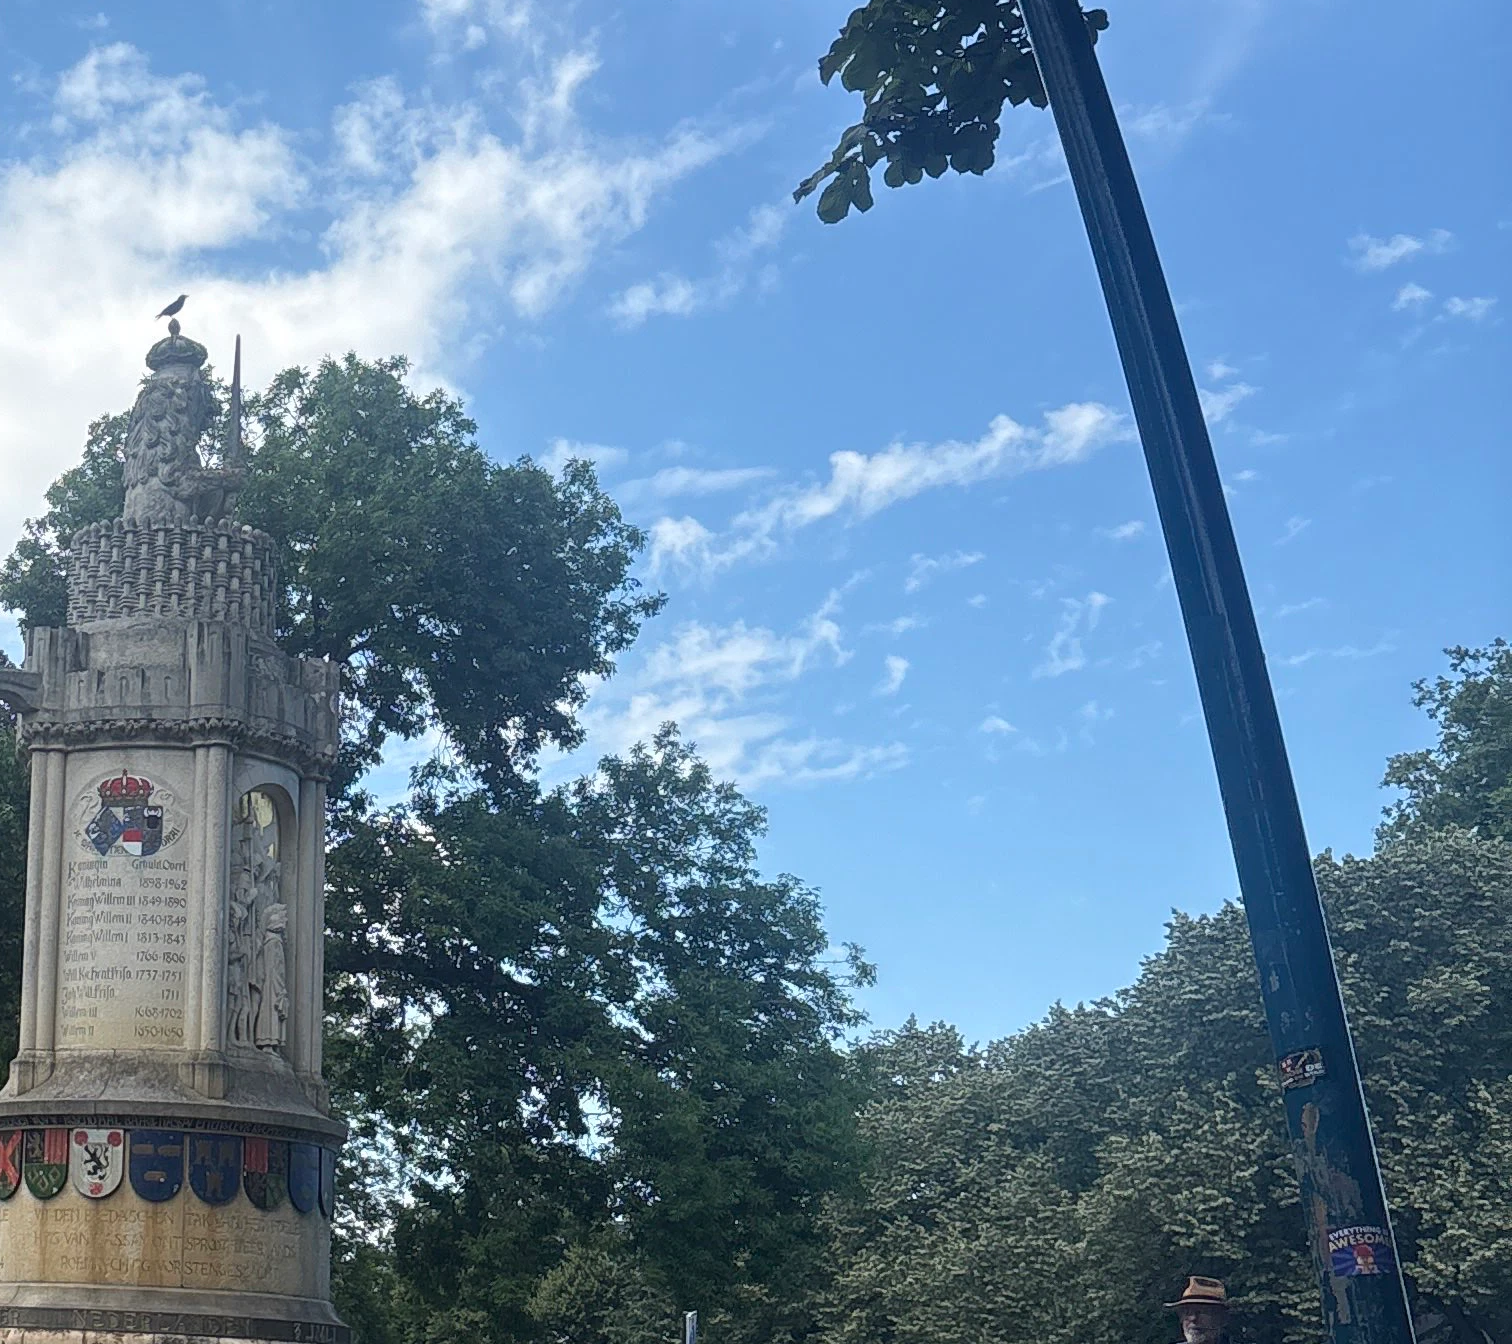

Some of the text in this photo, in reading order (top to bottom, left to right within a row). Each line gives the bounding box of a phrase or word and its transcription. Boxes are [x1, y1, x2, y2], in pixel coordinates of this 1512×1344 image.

[139, 877, 188, 890] 1898-1962
[94, 892, 125, 906] Willem
[127, 895, 136, 906] III
[138, 896, 187, 908] 1849-1890
[93, 911, 124, 924] Willem
[138, 914, 187, 927] 1840-1849
[92, 929, 123, 943] Willem
[64, 950, 88, 963] Willem
[135, 969, 182, 983] 1737-1751
[161, 989, 179, 1000] 1711
[62, 1006, 87, 1018] Willem
[54, 1208, 80, 1222] DEN
[1328, 1226, 1382, 1241] EVERYTHING
